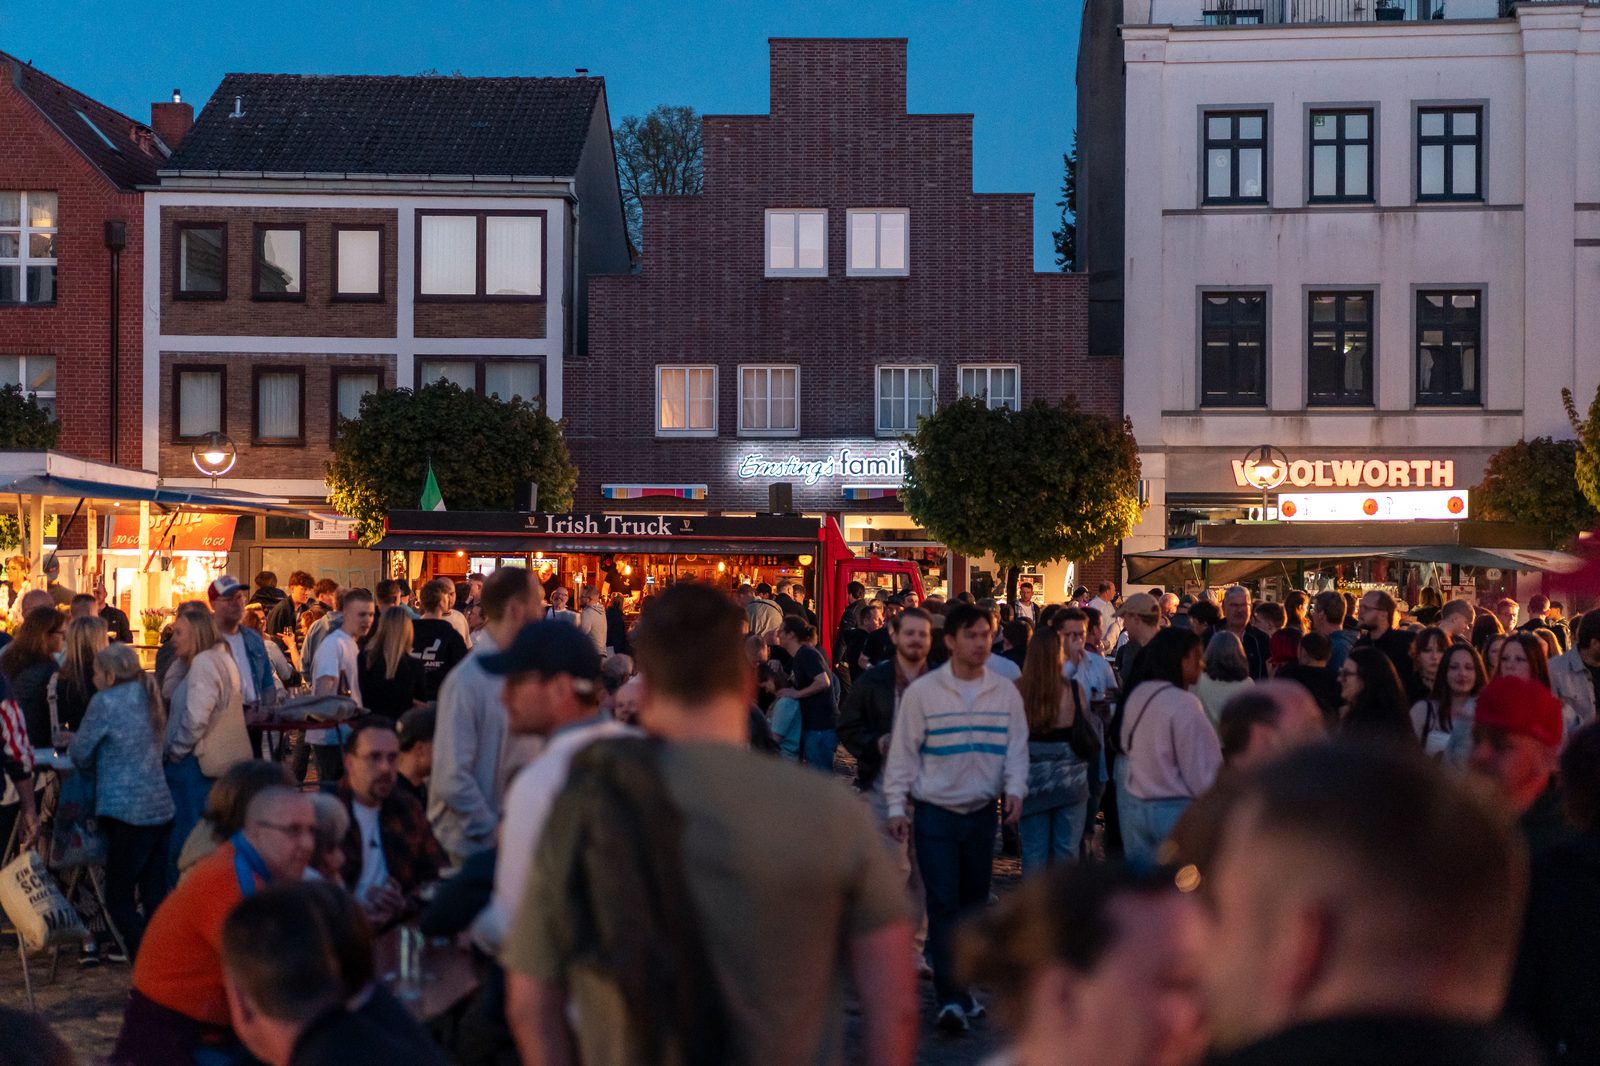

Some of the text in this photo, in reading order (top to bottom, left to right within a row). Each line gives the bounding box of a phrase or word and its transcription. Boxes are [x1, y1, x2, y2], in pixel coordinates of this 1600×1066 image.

[738, 448, 908, 485] Ernsting's famil
[1231, 459, 1454, 487] WOOLWORTH
[545, 514, 672, 535] Irish Truck
[115, 535, 126, 544] TO
[202, 537, 225, 546] TO GO
